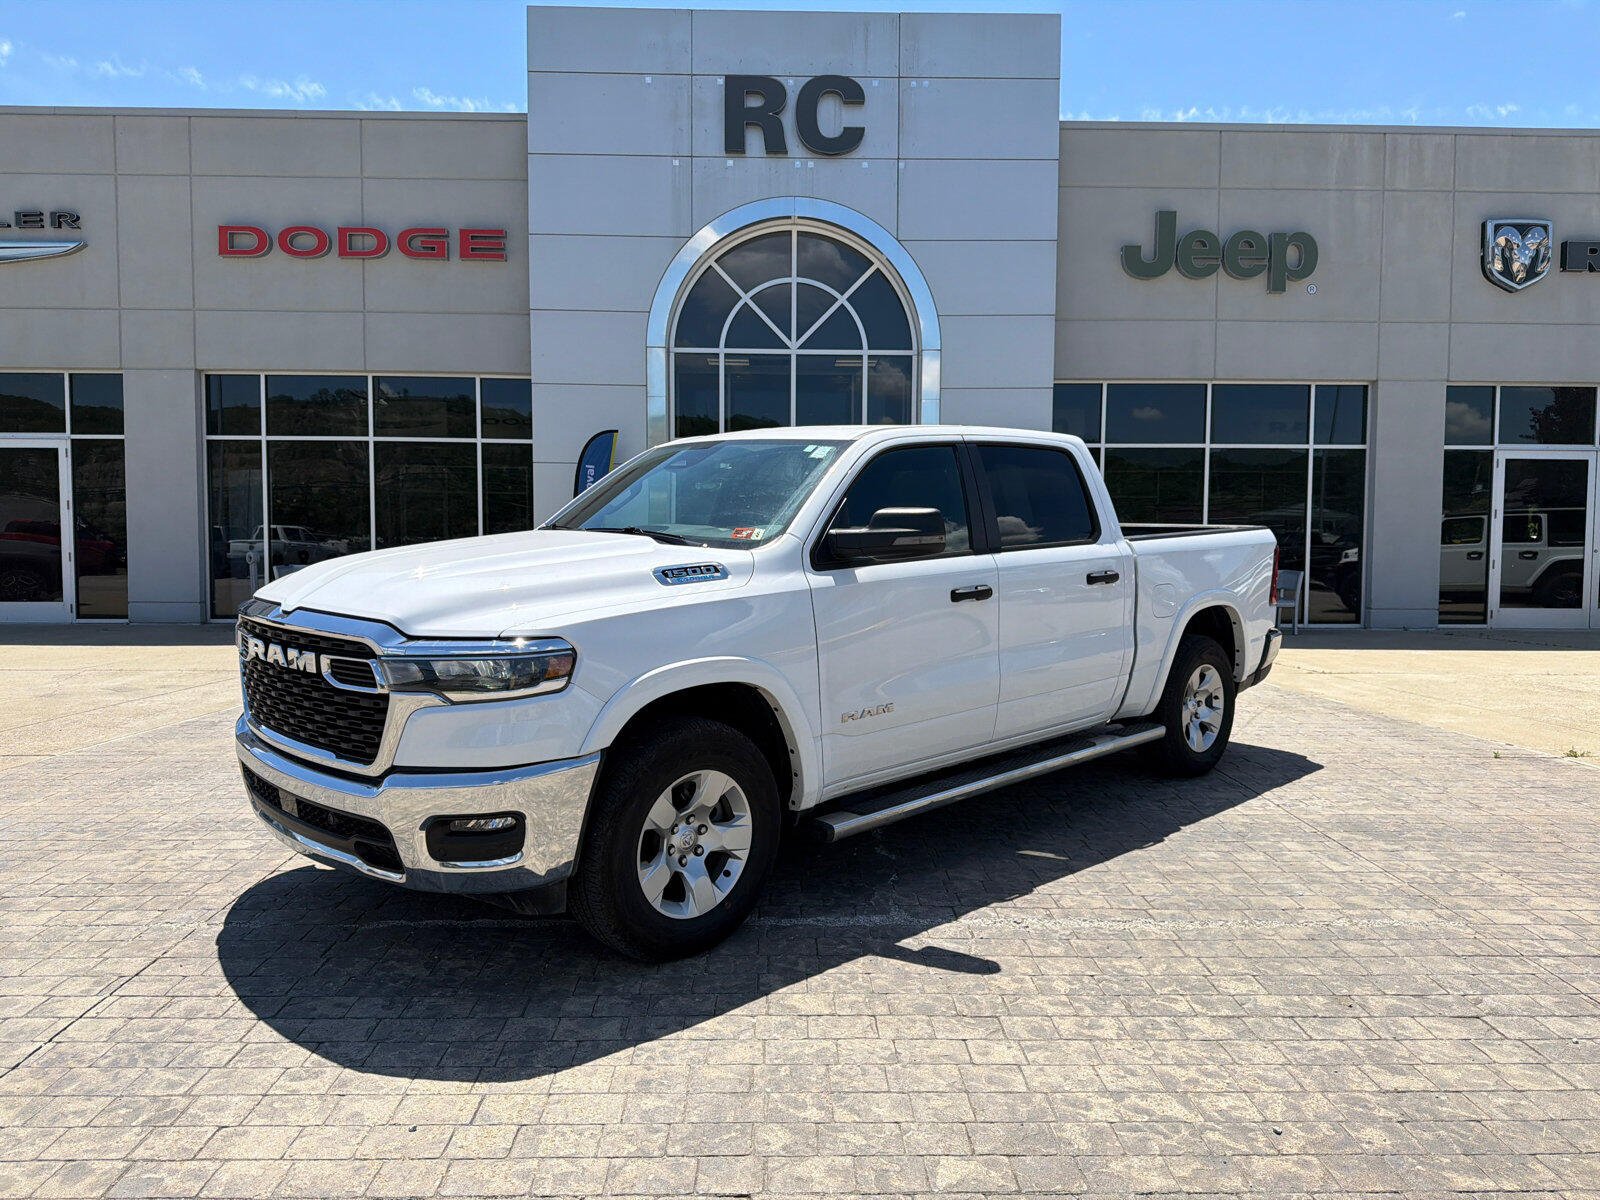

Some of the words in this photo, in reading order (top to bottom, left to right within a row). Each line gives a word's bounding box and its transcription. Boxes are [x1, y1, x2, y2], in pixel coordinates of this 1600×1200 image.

[724, 74, 866, 156] RC
[218, 225, 507, 261] DODGE
[1121, 210, 1319, 294] Jeep
[663, 565, 717, 578] 1500
[247, 635, 317, 674] RAM
[841, 702, 894, 723] RAM
